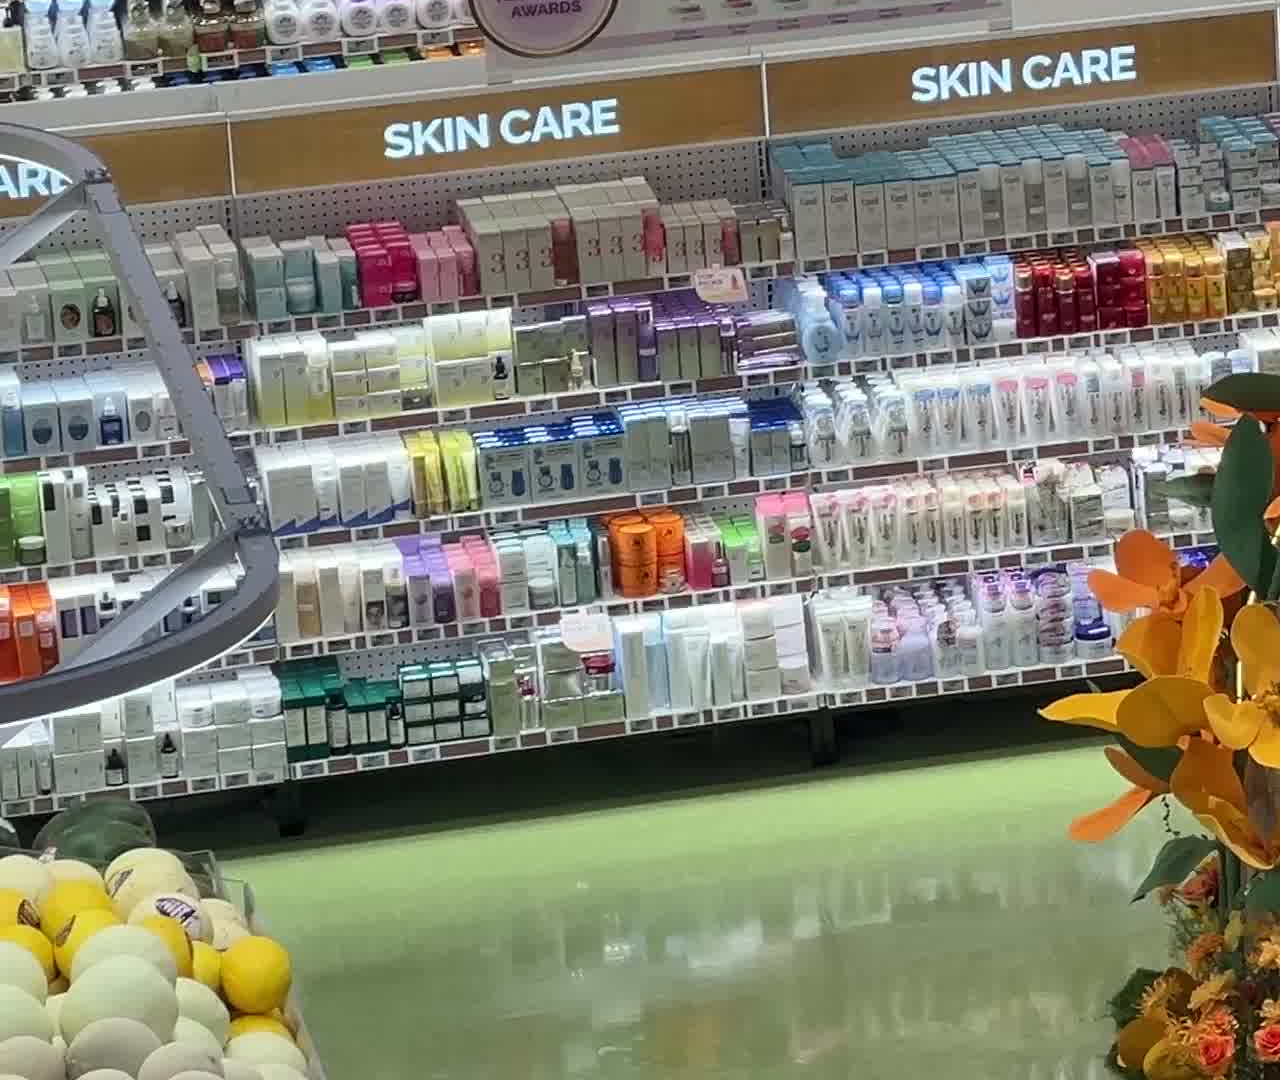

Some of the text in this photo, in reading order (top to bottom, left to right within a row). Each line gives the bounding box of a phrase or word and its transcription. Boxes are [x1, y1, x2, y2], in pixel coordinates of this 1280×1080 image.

[910, 43, 1138, 104] SKIN CARE
[382, 98, 621, 160] SKIN CARE
